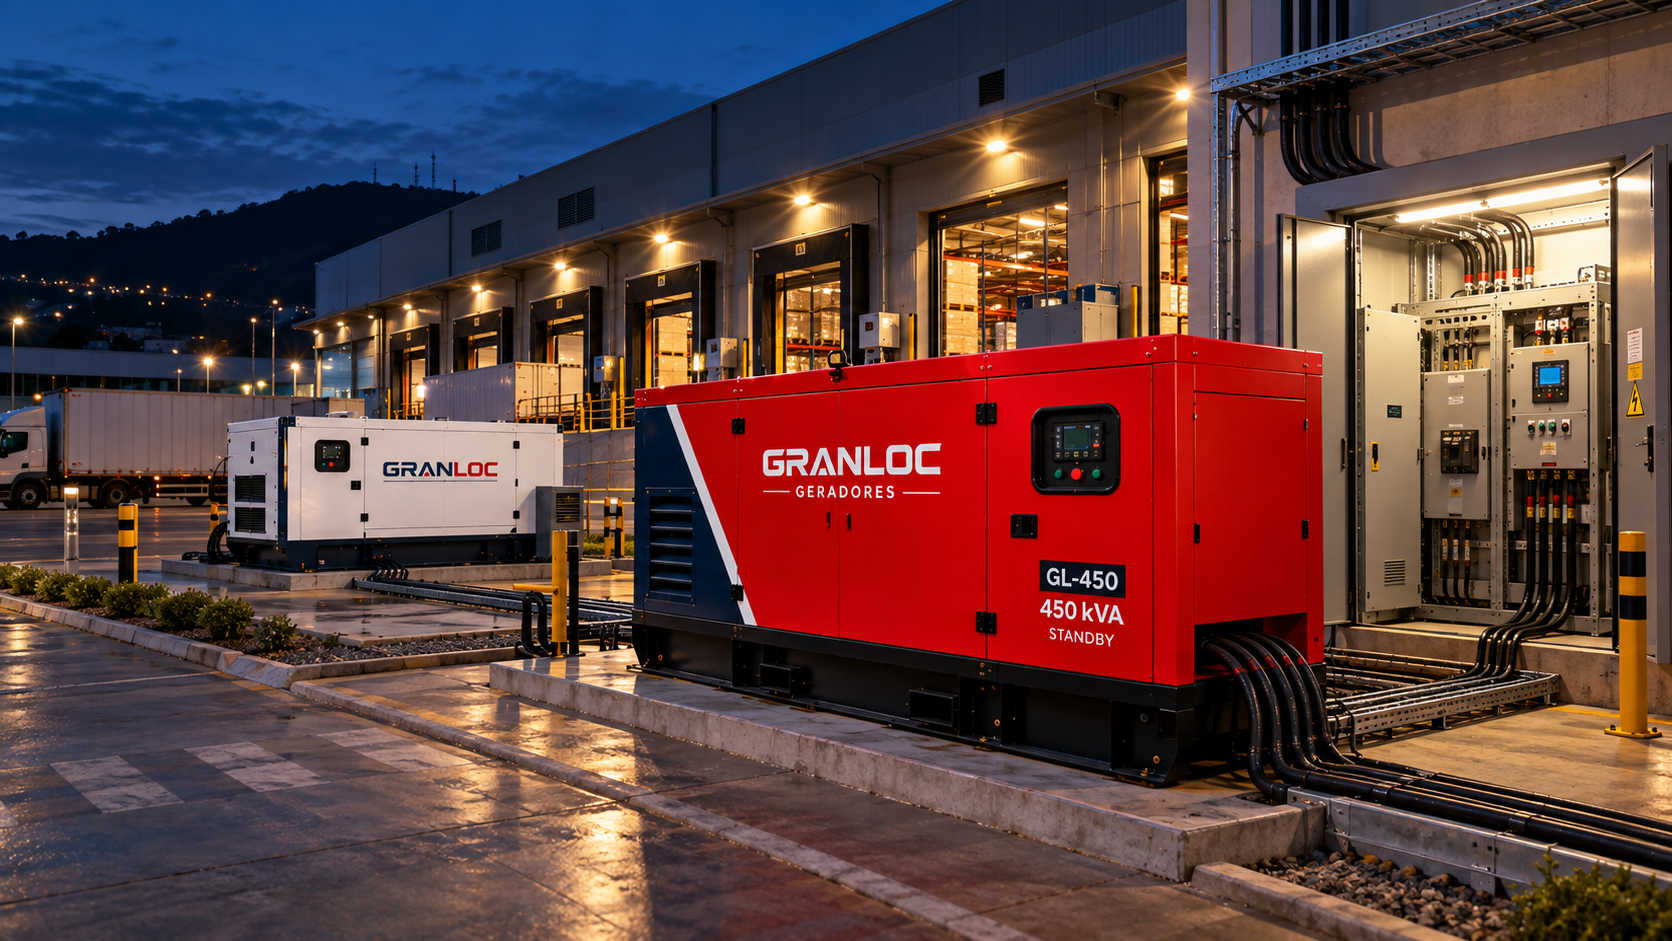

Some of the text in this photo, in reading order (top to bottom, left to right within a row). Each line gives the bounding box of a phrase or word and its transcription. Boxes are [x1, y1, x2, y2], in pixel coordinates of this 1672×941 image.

[382, 461, 499, 478] GRANLOC
[762, 442, 942, 477] GRANLOC
[795, 485, 895, 499] GERADORES
[1046, 567, 1119, 591] GL-450
[1039, 599, 1125, 626] 450 kVA
[1049, 627, 1115, 647] STANDBY
